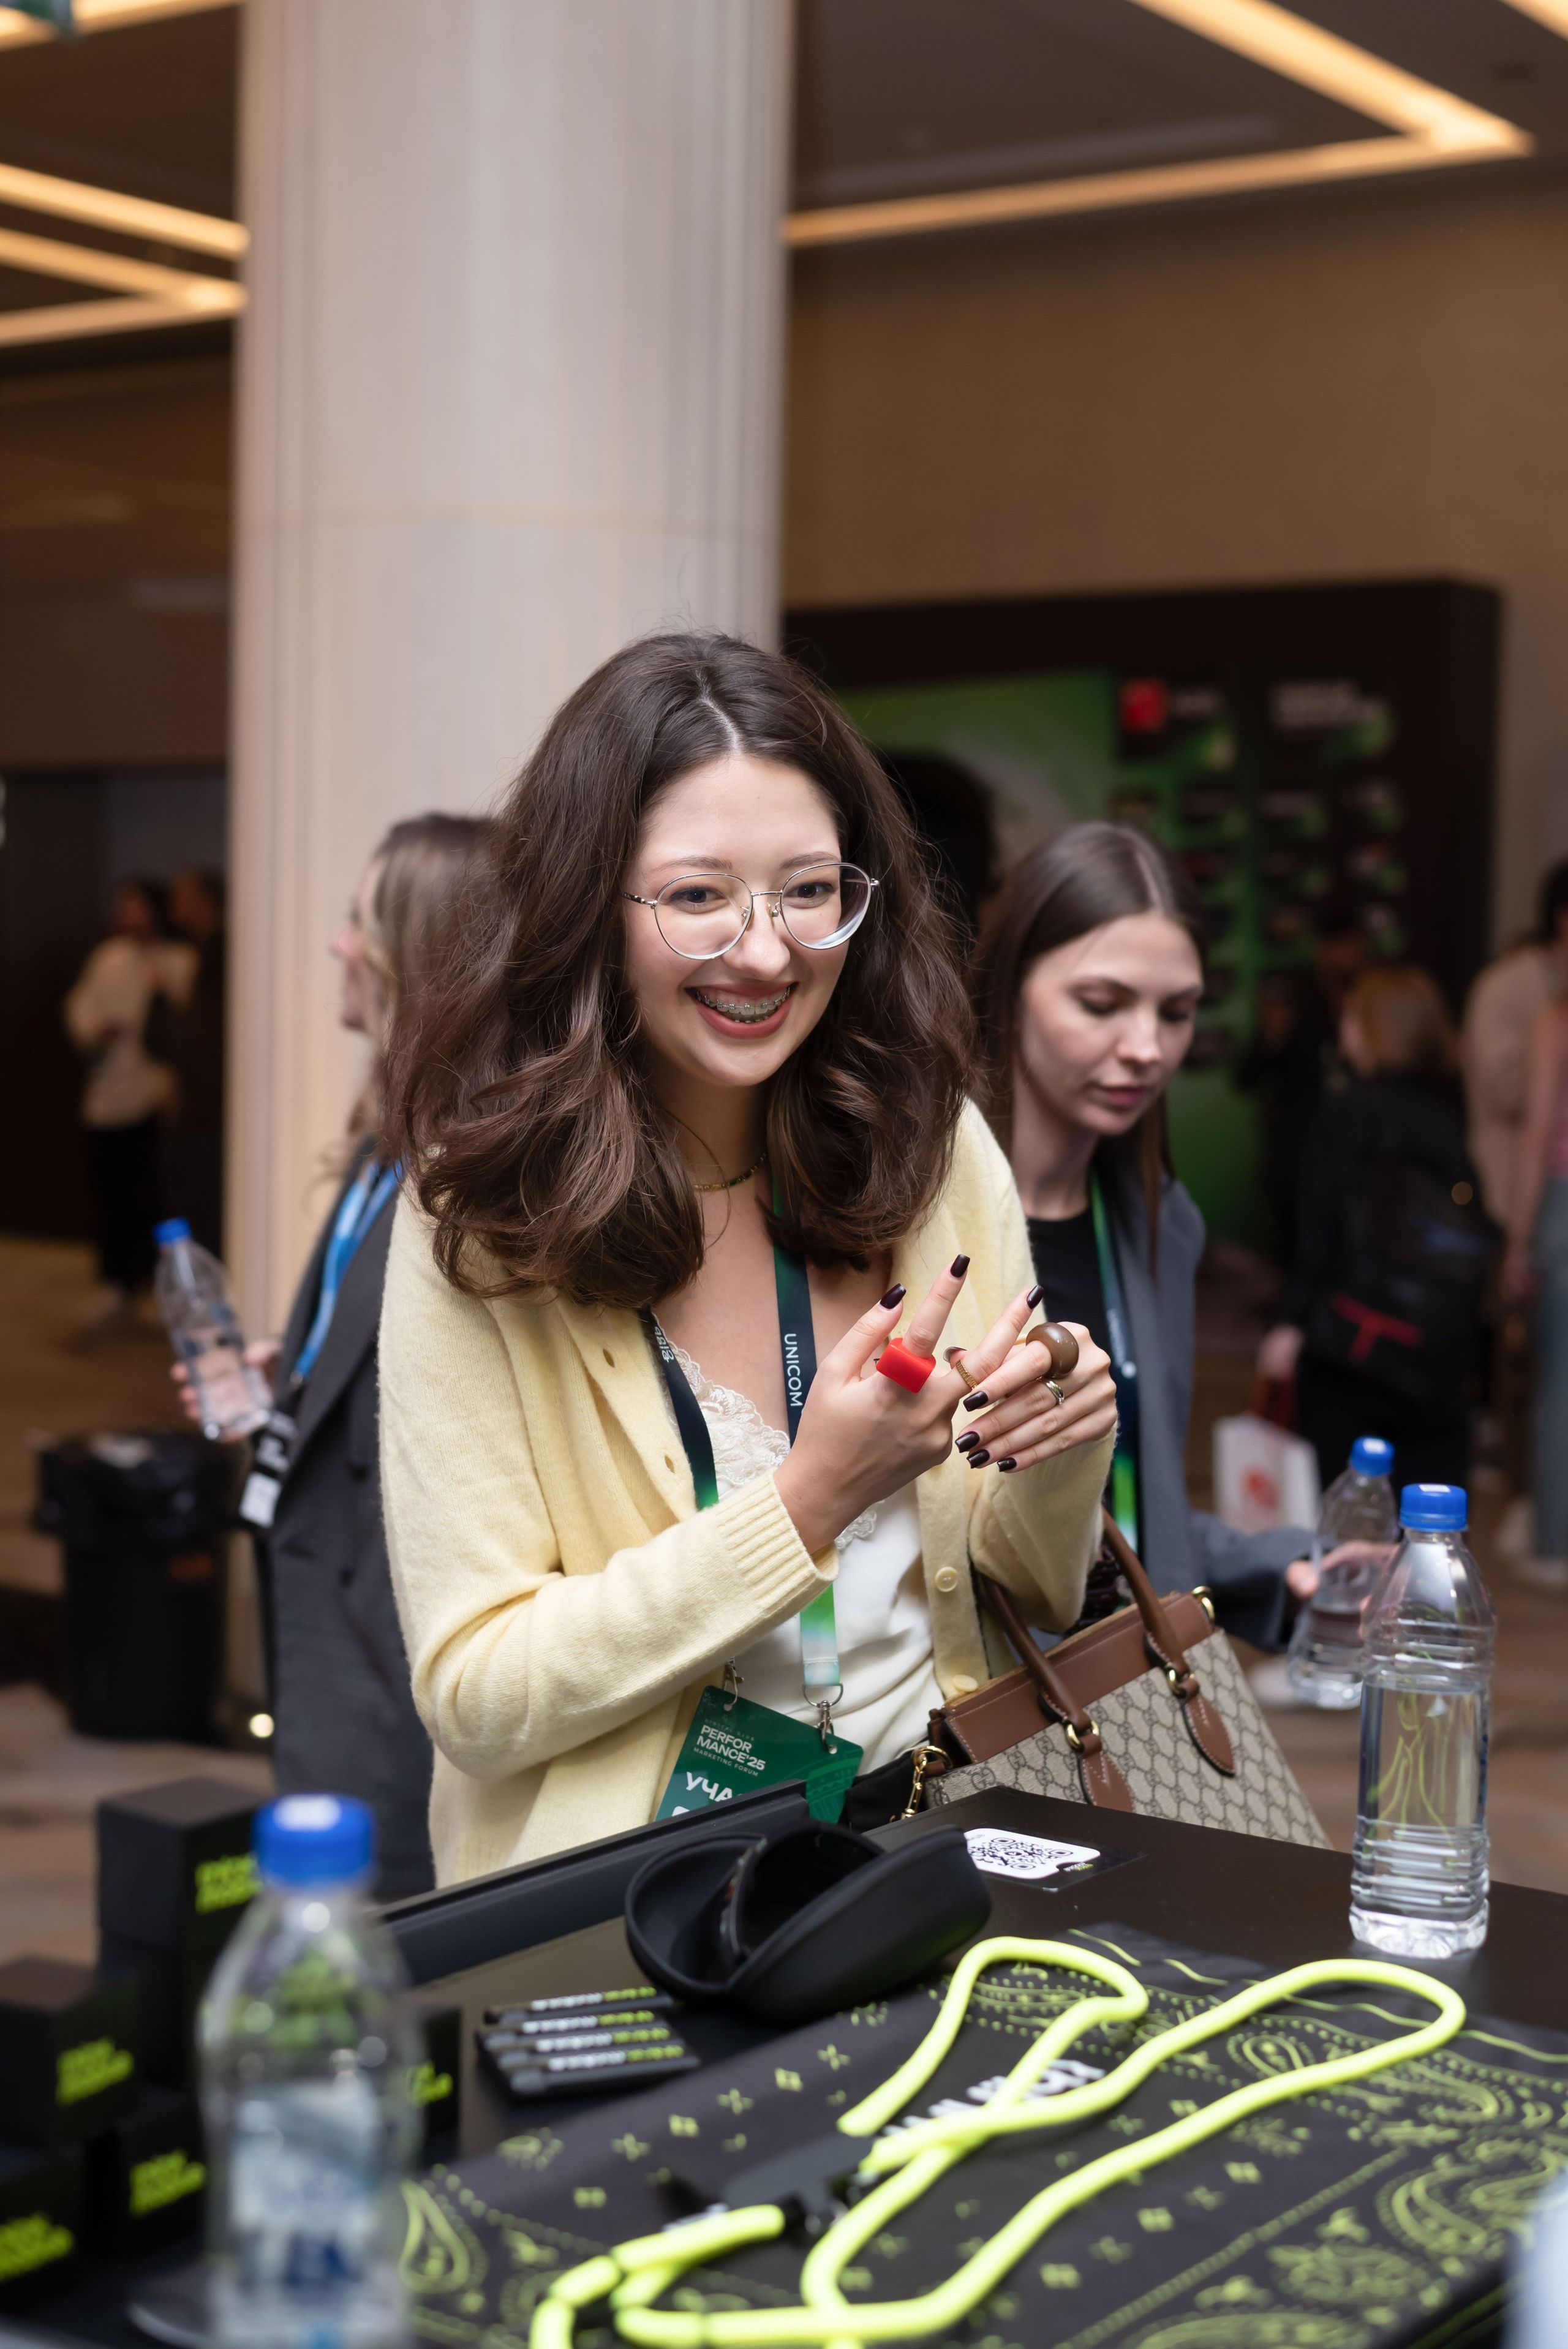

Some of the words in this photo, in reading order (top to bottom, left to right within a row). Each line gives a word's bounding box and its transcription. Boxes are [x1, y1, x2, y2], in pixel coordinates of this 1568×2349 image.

[784, 1333, 803, 1406] UNICOM
[696, 1735, 766, 1771] MANCE'25
[701, 1724, 752, 1753] PERFOR
[693, 1747, 733, 1766] MARKETING
[734, 1763, 758, 1777] FORUM
[685, 1771, 742, 1802] УЧА
